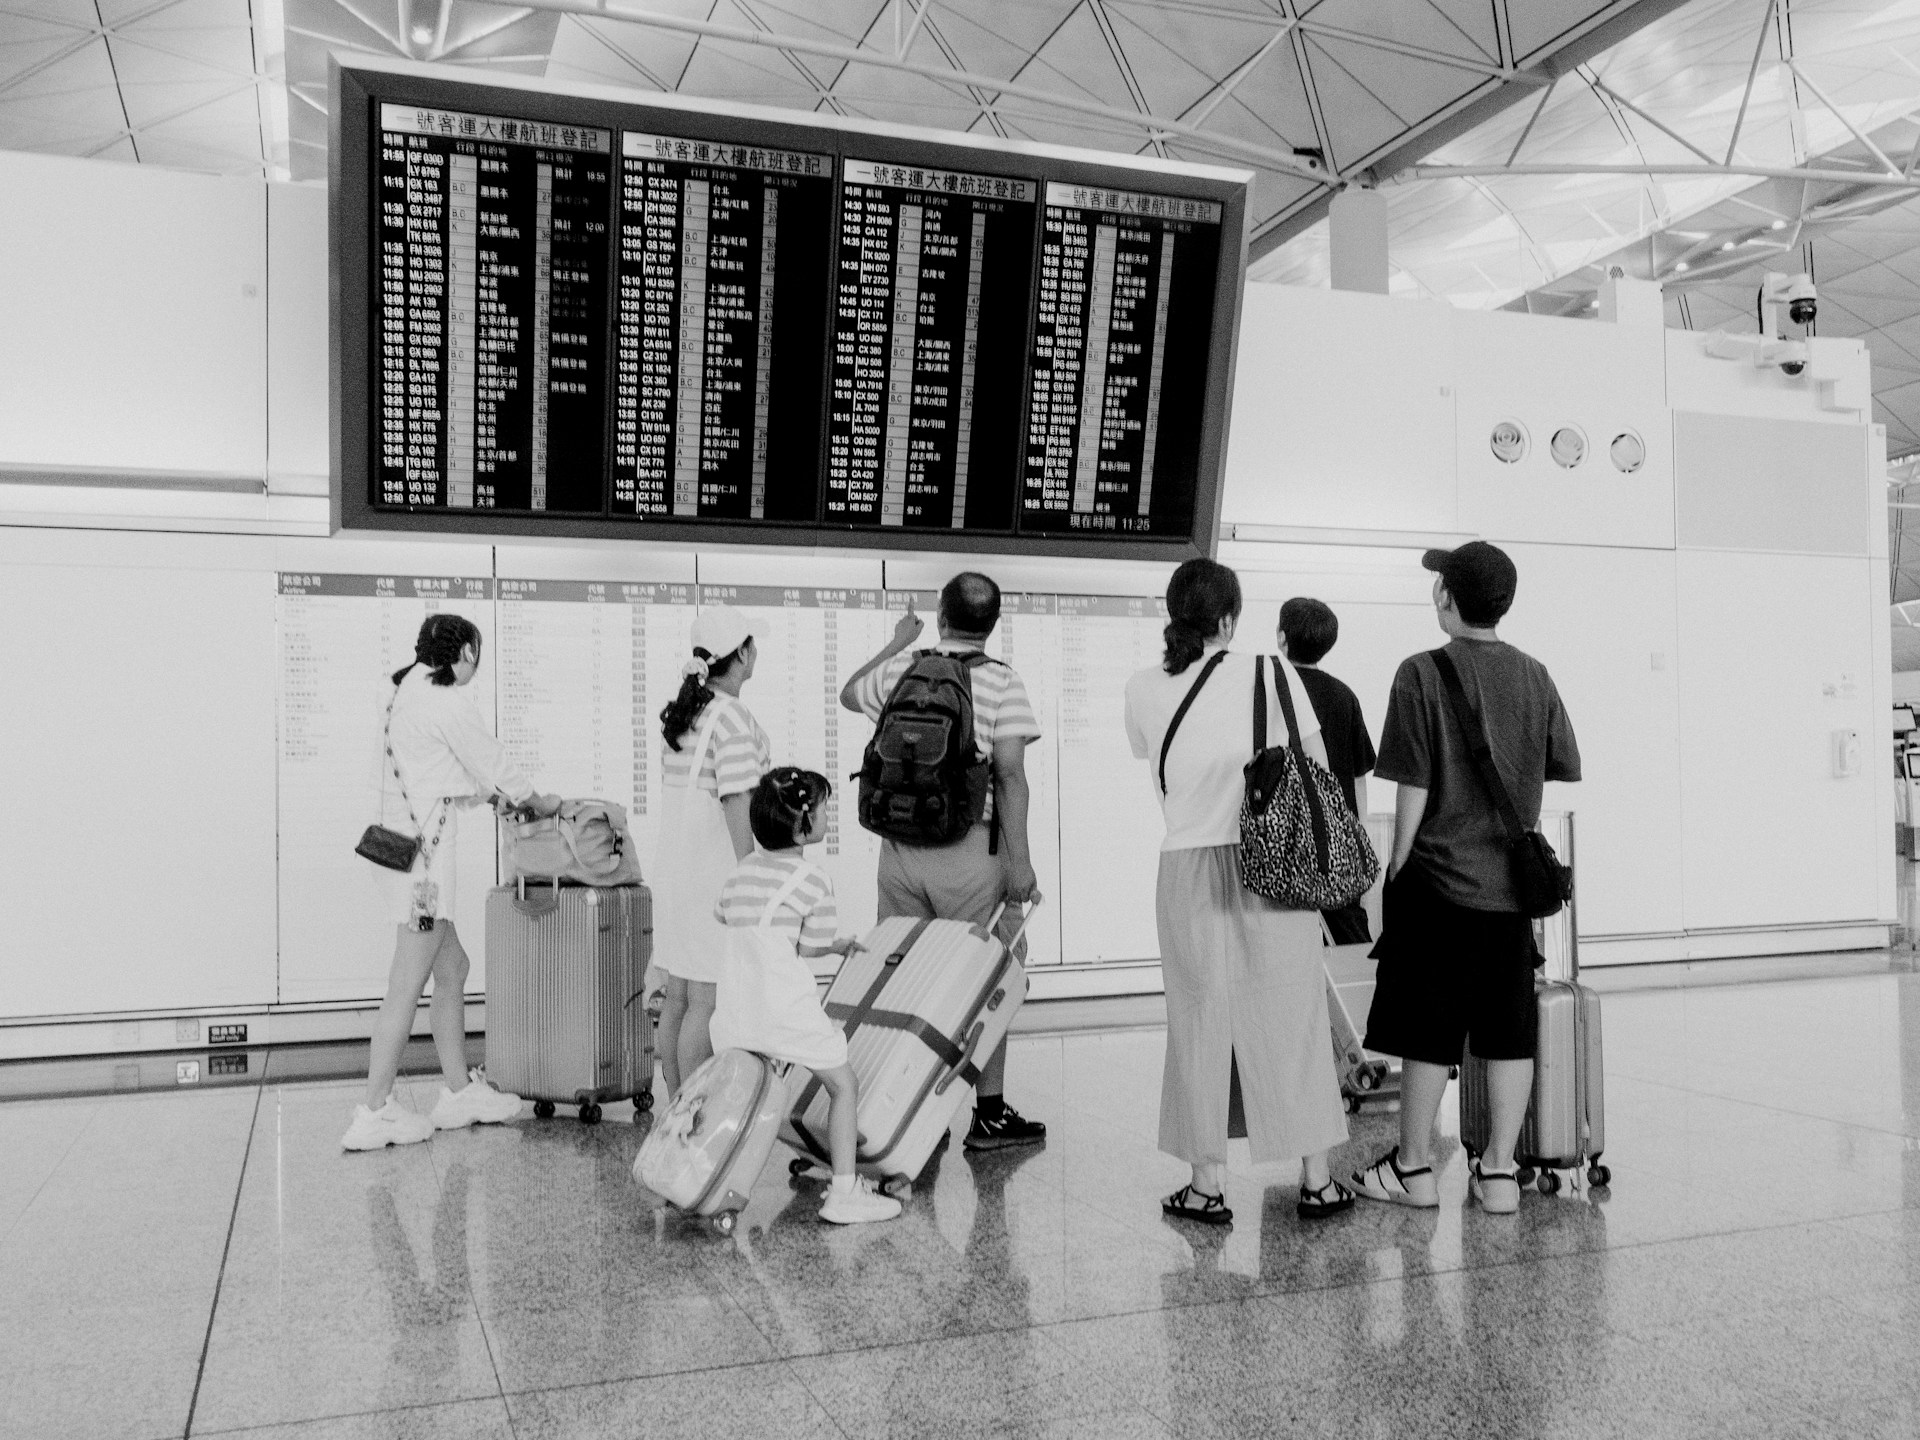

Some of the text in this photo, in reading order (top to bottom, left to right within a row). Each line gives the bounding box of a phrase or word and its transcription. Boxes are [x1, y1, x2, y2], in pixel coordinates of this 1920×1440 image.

[396, 111, 598, 150] 一號客運大樓航班登記
[636, 138, 821, 174] 一號客運大樓航班登記
[648, 177, 659, 189] CX
[660, 178, 677, 190] 2474
[713, 184, 730, 195] 台北
[857, 165, 1026, 199] 一號客運大樓航班登記
[648, 190, 660, 201] FM
[844, 200, 862, 211] 14:30
[866, 202, 877, 212] VN
[410, 217, 422, 229] HX
[843, 224, 861, 235] 14:35
[865, 226, 876, 236] CA
[876, 228, 888, 237] 112
[622, 237, 642, 249] 13:05
[711, 246, 728, 258] 天津
[842, 236, 860, 247] 14:35
[865, 239, 875, 248] HX
[875, 240, 888, 249] 612
[622, 250, 641, 262] 13:10
[646, 252, 657, 264] CX
[659, 254, 671, 264] 157
[841, 260, 859, 271] 14:35
[863, 262, 875, 272] MH
[875, 264, 888, 273] 073
[621, 275, 640, 287] 13:10
[645, 277, 657, 288] HU
[840, 284, 858, 294] 14:40
[862, 286, 873, 296] HU
[621, 300, 640, 312] 13:20
[644, 302, 655, 313] CX
[657, 303, 670, 314] 253
[620, 312, 639, 324] 13:25
[644, 314, 656, 325] UO
[657, 315, 670, 326] 700
[620, 337, 639, 348] 13:35
[643, 339, 655, 350] CA
[655, 339, 672, 350] 6518
[619, 349, 638, 361] 13:35
[655, 352, 668, 362] 310
[834, 390, 852, 400] 15:10
[856, 391, 866, 401] CX
[617, 432, 636, 443] 14:00
[640, 434, 653, 445] UO
[653, 435, 666, 444] 650
[831, 446, 849, 456] 15:20
[852, 448, 863, 456] VN
[851, 470, 862, 479] CA
[862, 470, 874, 479] 420
[616, 479, 635, 490] 14:25
[639, 480, 650, 490] CX
[1069, 514, 1151, 531] 現在時間 11:25
